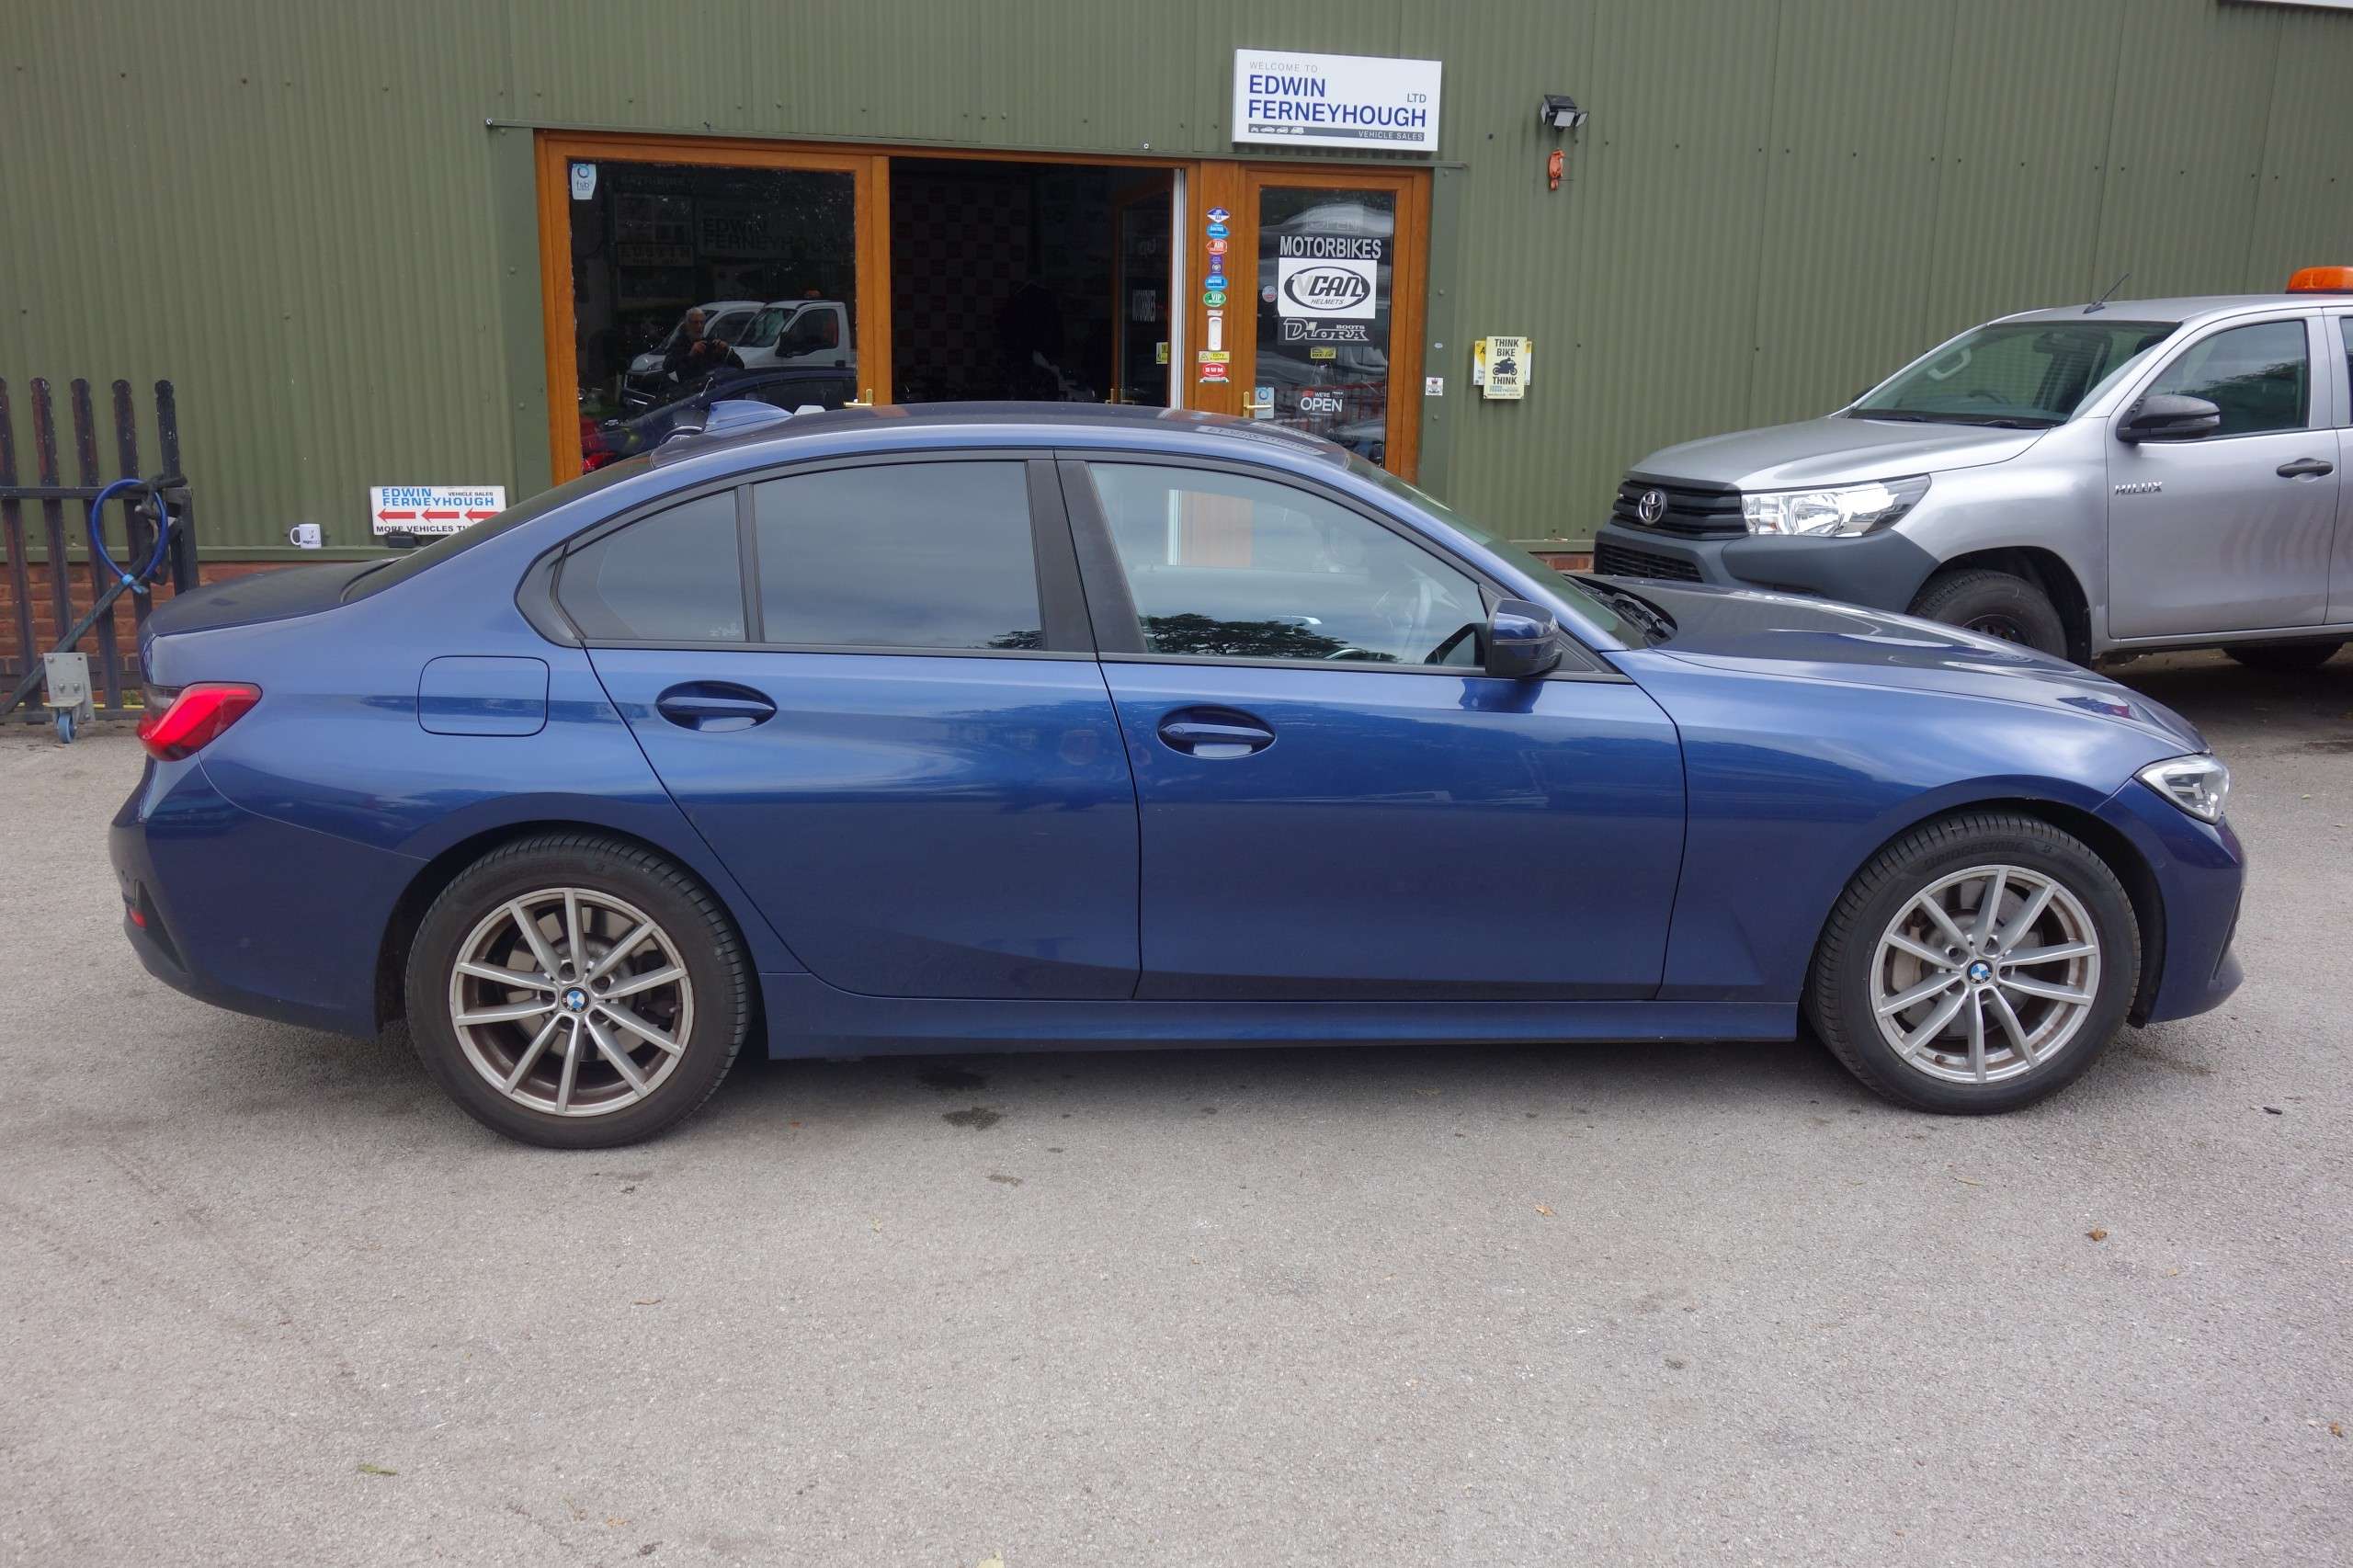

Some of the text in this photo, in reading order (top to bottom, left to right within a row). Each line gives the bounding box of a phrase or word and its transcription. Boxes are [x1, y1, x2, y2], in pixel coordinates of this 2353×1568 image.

[1249, 62, 1318, 74] WELCOME TO
[1249, 74, 1325, 97] EDWIN
[1406, 93, 1427, 104] LTD
[1248, 98, 1426, 127] FERNEYHOUGH
[1358, 130, 1423, 141] VEHICLE SALES
[1279, 235, 1381, 259] MOTORBIKES
[1495, 338, 1519, 347] THINK
[1496, 347, 1516, 357] BIKE
[1493, 376, 1518, 385] THINK
[1300, 397, 1343, 412] OPEN
[382, 488, 432, 497] EDWIN
[2115, 481, 2163, 495] HILUX
[382, 497, 494, 506] FERNEYHOUGH
